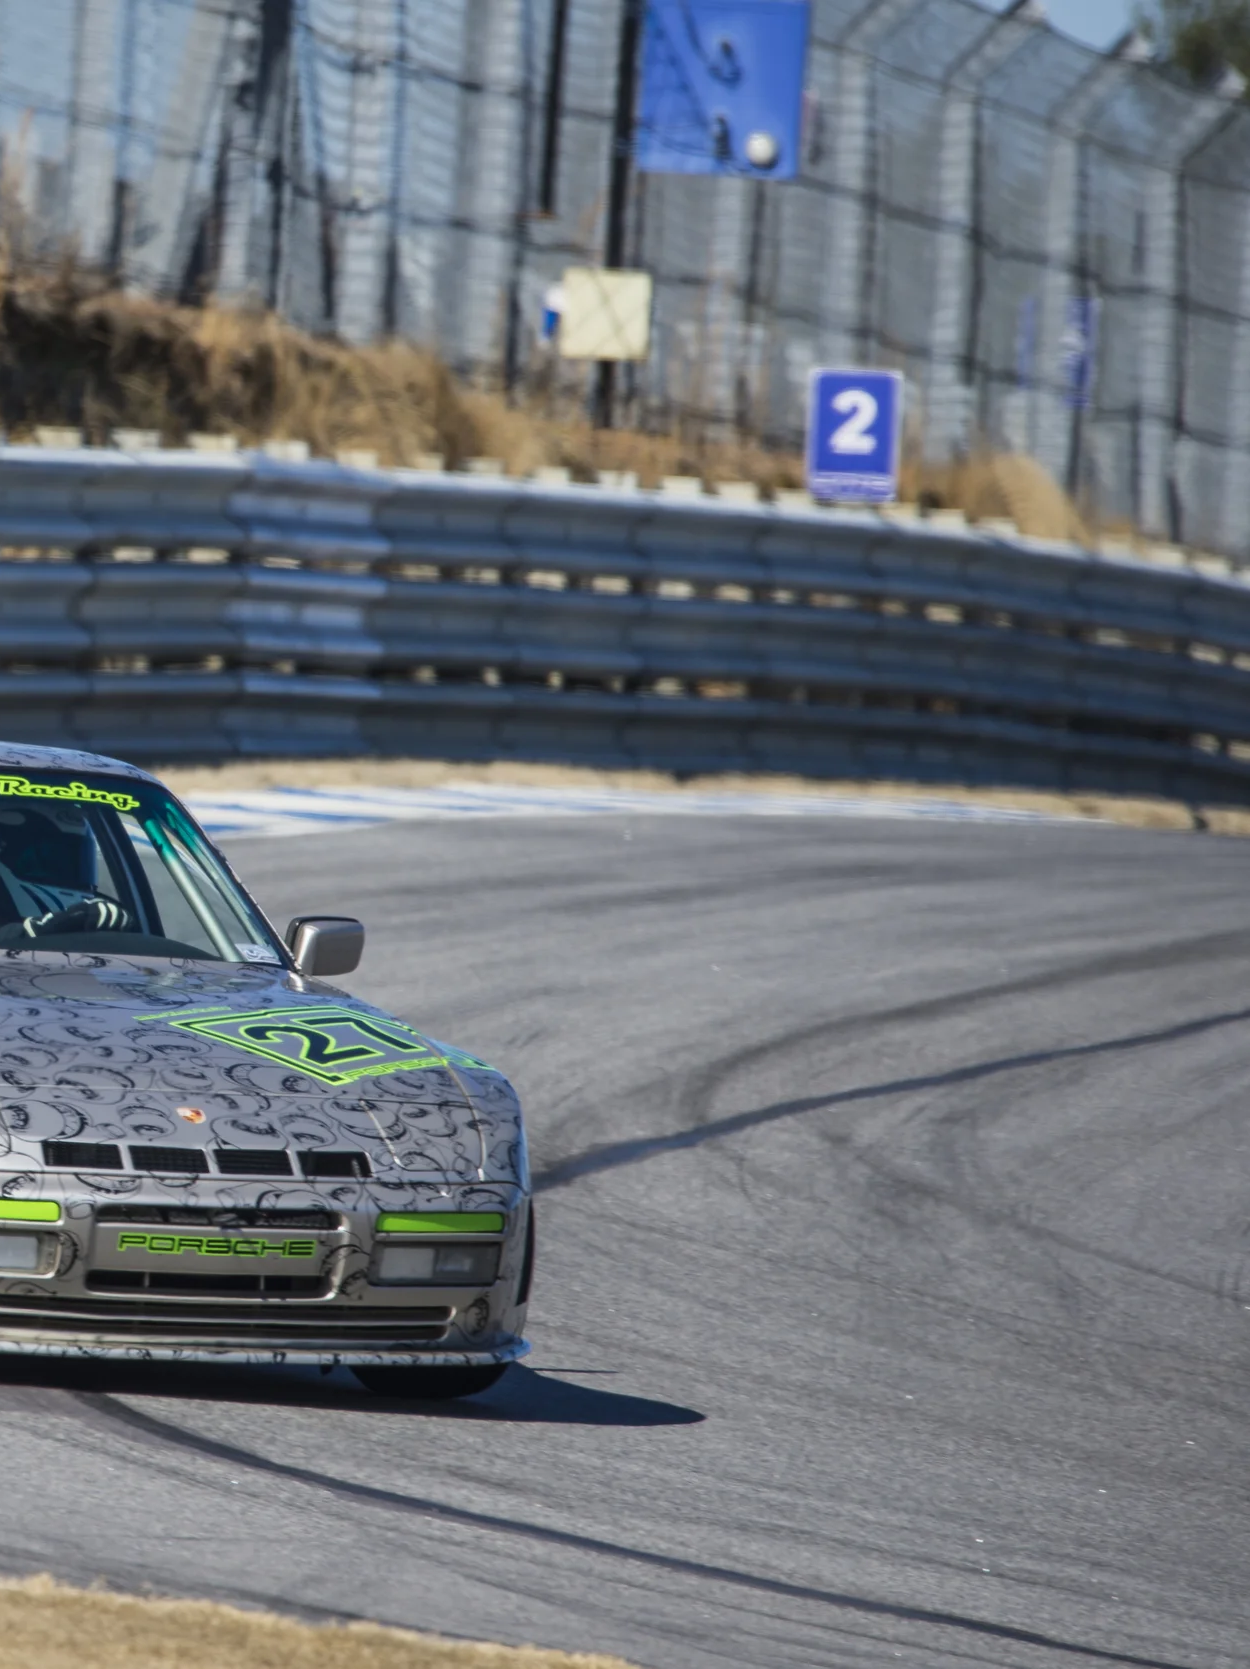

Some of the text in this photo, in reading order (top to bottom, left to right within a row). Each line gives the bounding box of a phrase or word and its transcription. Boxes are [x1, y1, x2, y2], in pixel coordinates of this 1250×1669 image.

[828, 387, 879, 456] 2
[238, 1014, 428, 1067] 27
[117, 1231, 317, 1258] PORSCHE
